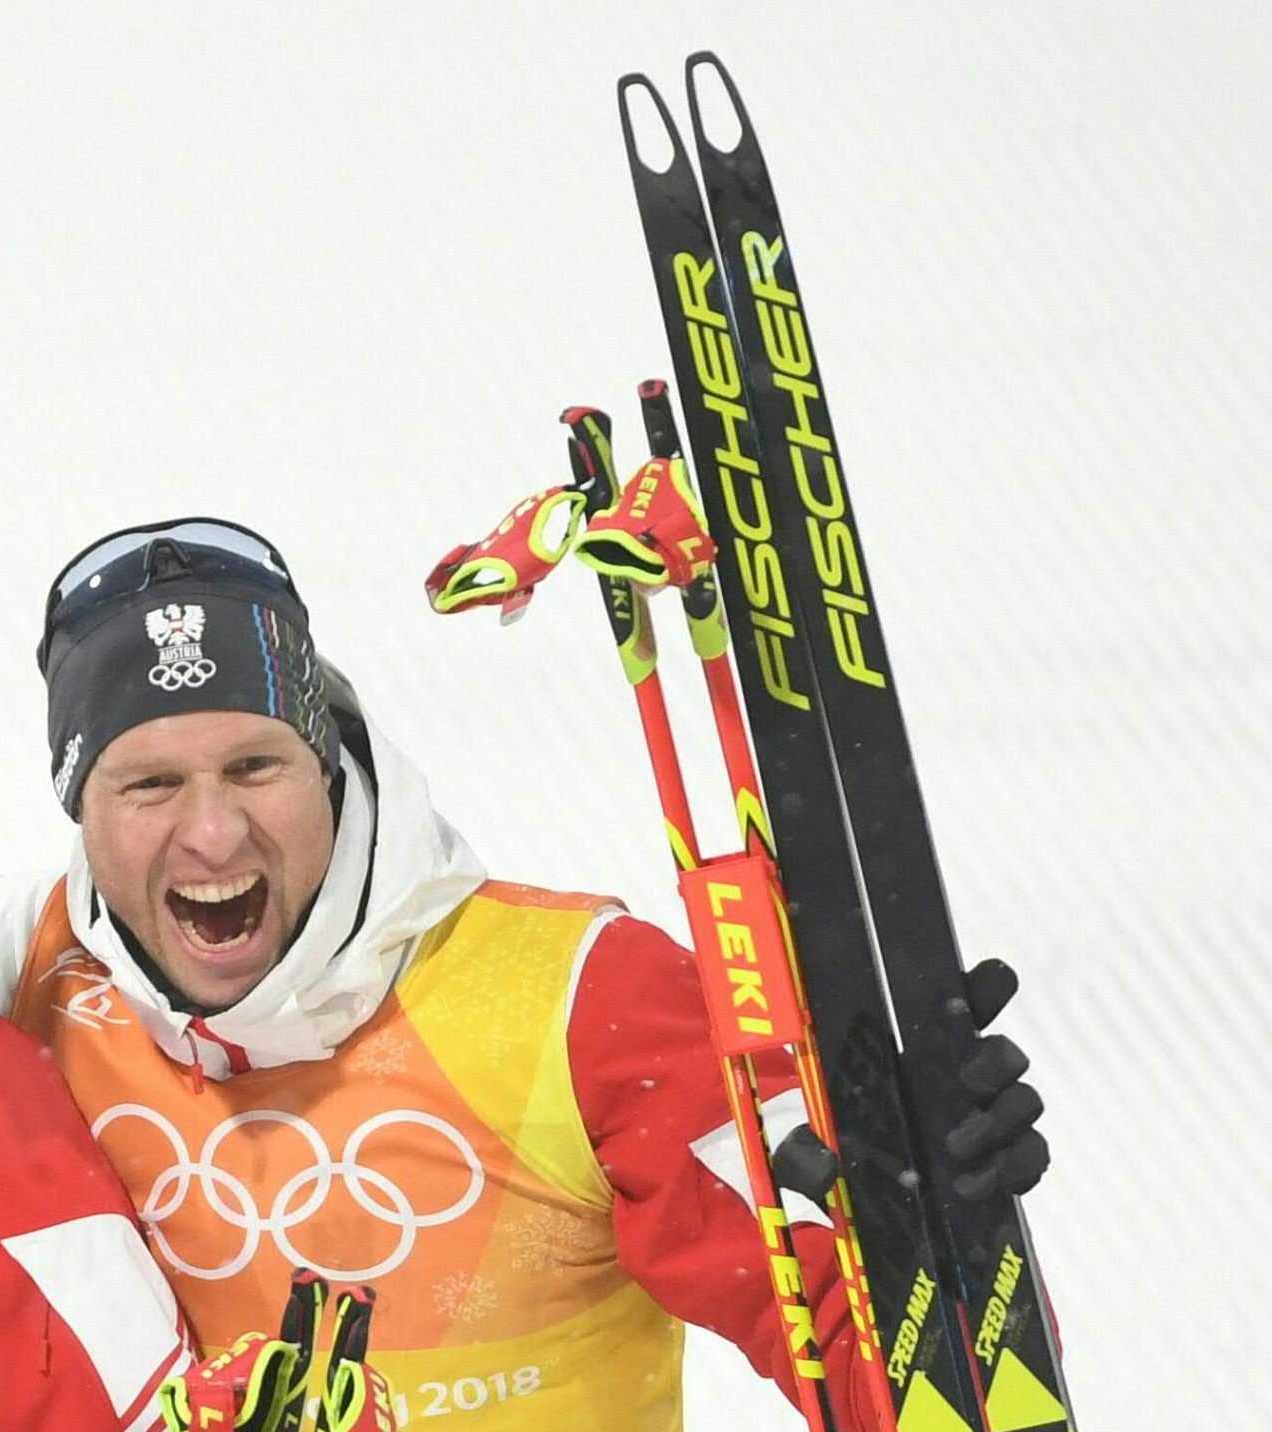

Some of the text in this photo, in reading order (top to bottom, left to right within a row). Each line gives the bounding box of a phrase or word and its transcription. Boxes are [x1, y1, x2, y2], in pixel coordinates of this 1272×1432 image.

[629, 462, 663, 519] LEKI
[673, 251, 811, 711] FISCHER
[740, 229, 886, 689] FISCHER
[159, 645, 203, 664] AUSTRIA
[706, 881, 774, 1036] LEKI
[758, 1205, 825, 1379] LEKI
[418, 1365, 542, 1417] 2018
